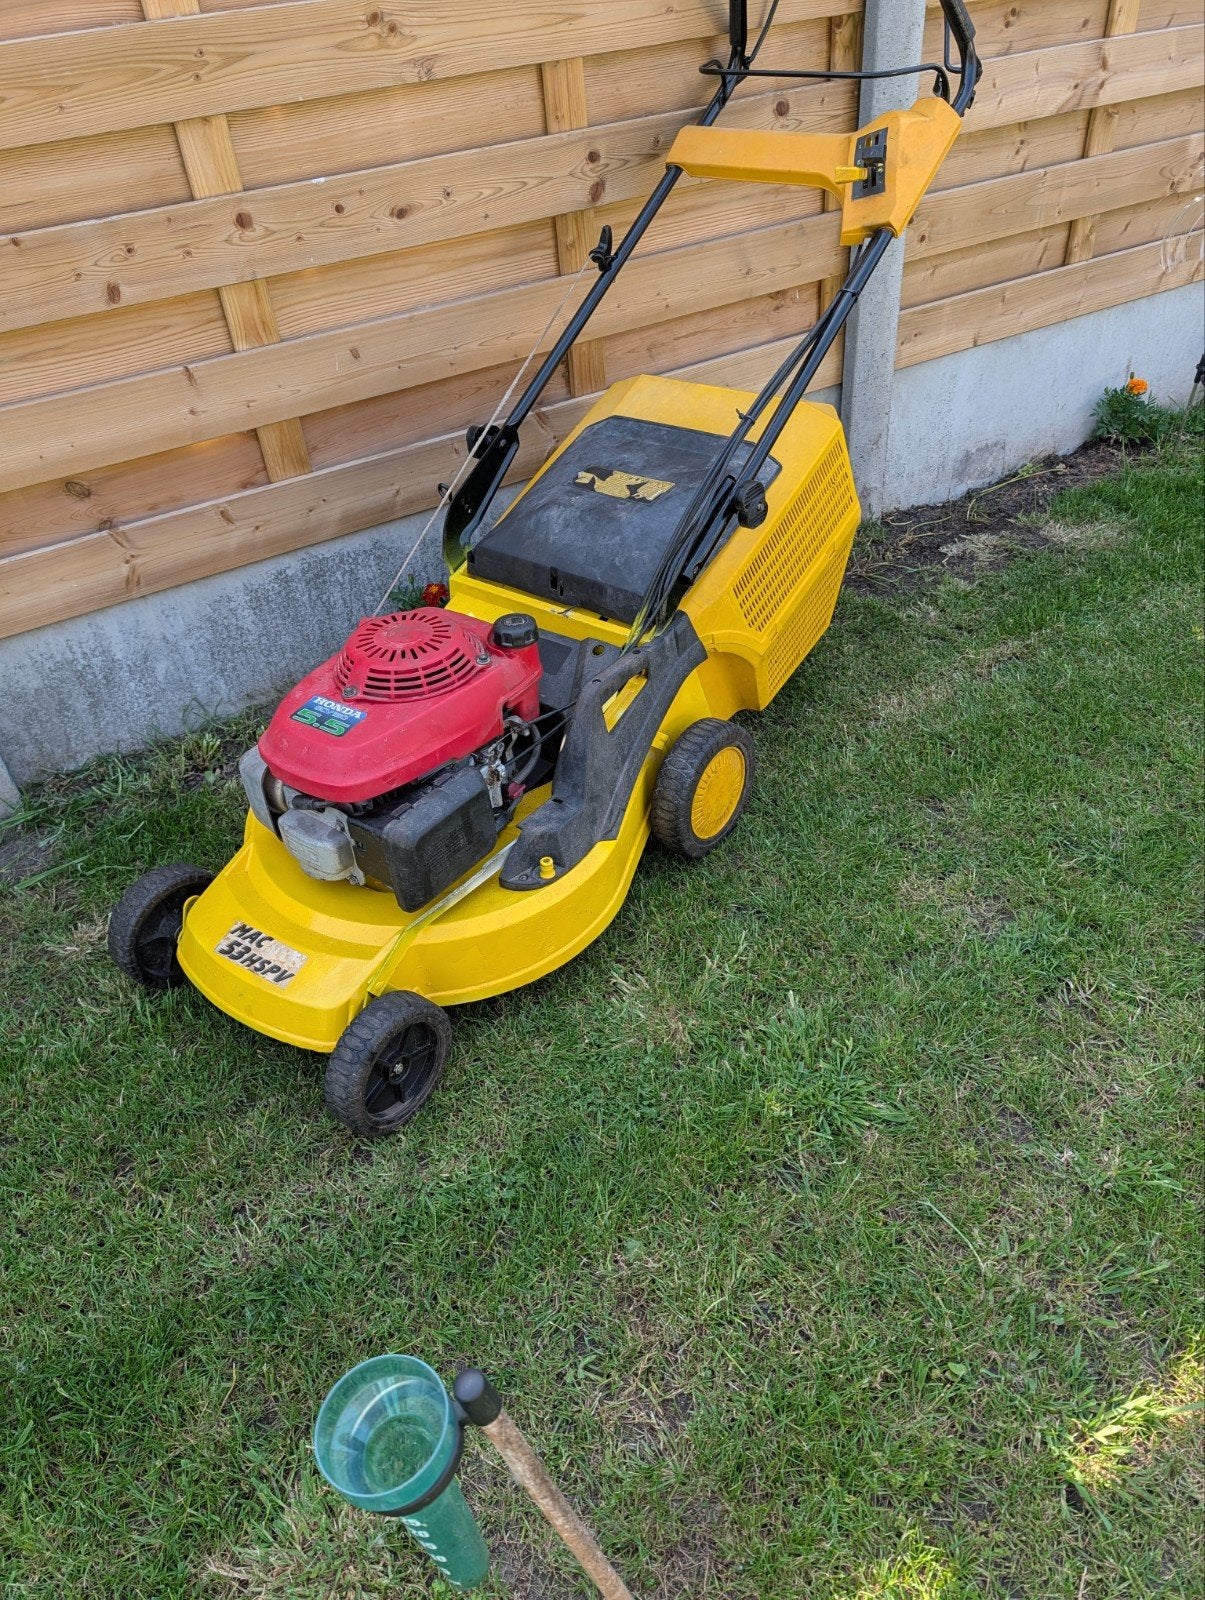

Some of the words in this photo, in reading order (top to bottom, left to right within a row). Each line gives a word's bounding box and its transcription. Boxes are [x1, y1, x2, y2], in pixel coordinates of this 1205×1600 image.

[313, 696, 362, 718] HONDA
[292, 708, 351, 736] 5.5
[230, 923, 274, 948] MAC
[219, 940, 295, 983] 53HSPV
